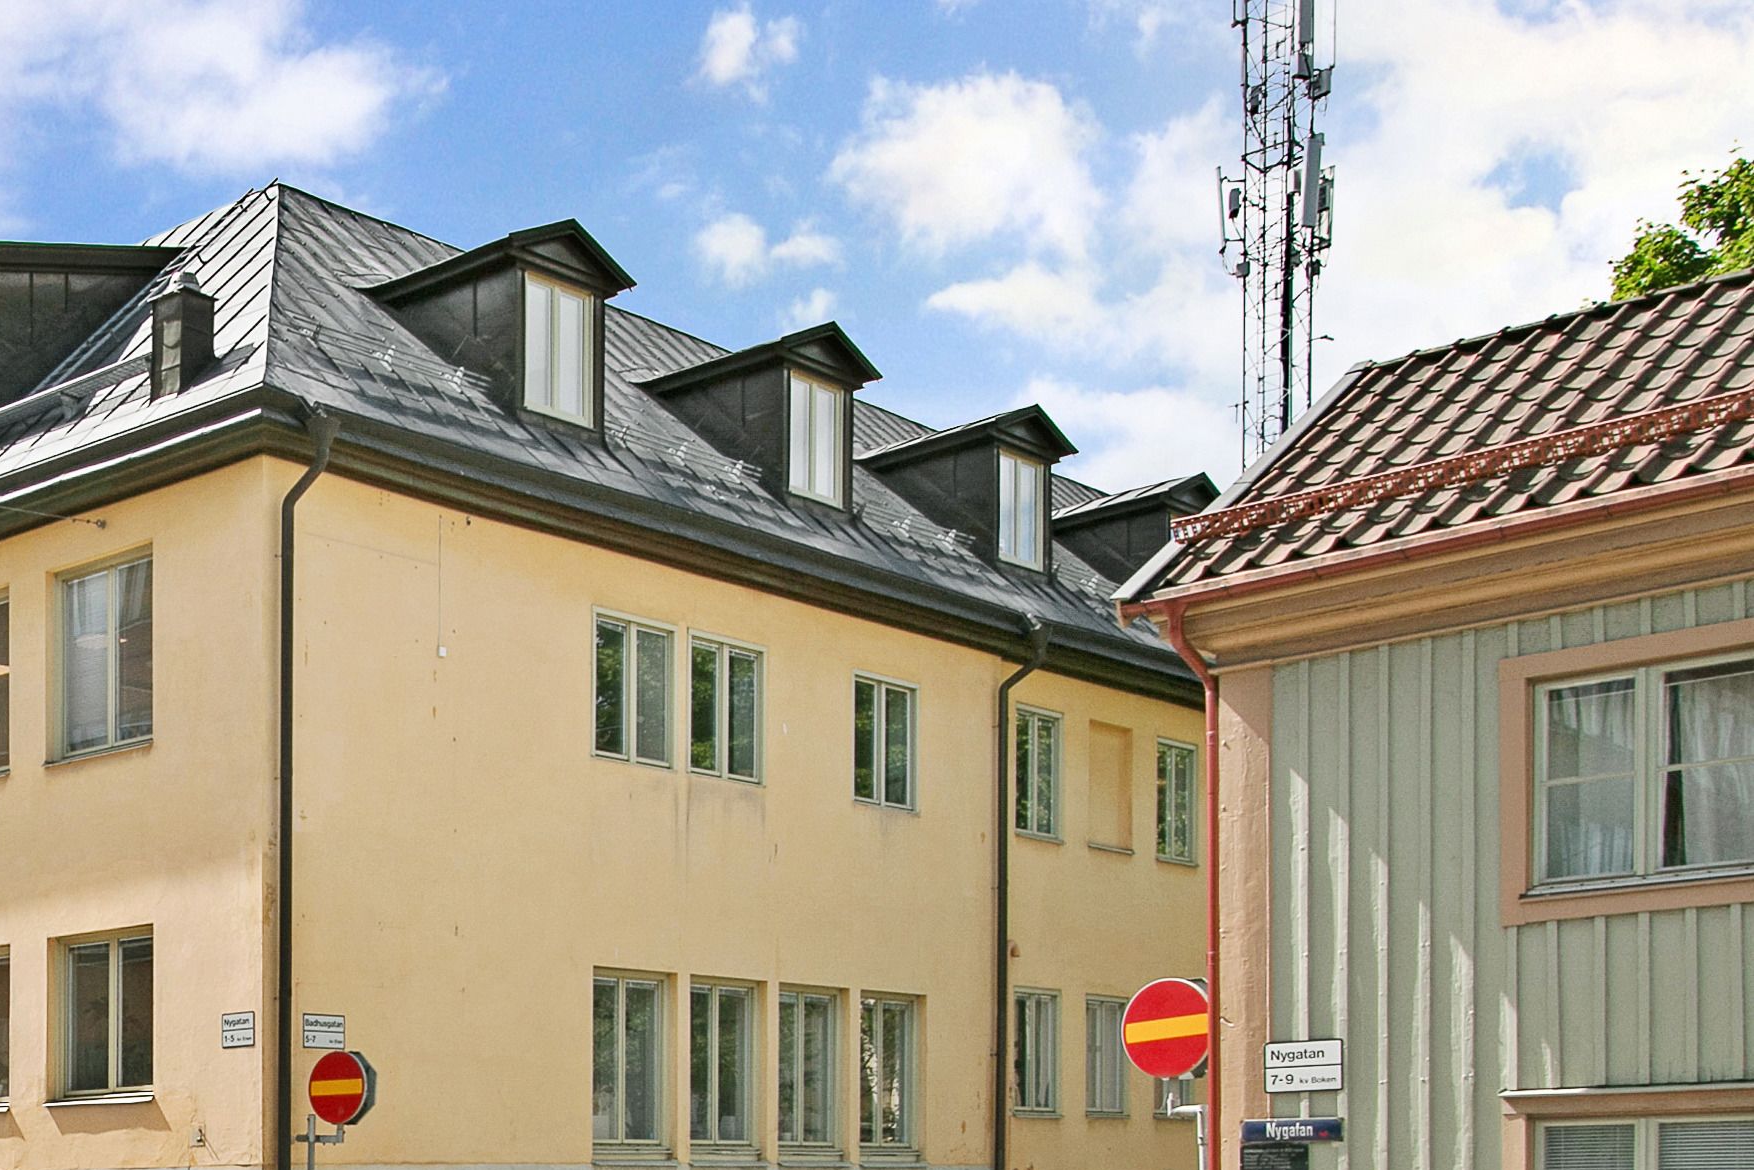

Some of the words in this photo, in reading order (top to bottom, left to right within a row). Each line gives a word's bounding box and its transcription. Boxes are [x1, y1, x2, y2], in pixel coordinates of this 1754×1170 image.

[224, 1018, 250, 1028] Nygatan
[305, 1018, 343, 1029] Badhusgatan
[1270, 1049, 1325, 1063] Nygatan
[1270, 1074, 1294, 1085] 7-9
[1265, 1121, 1313, 1140] Nygatan
